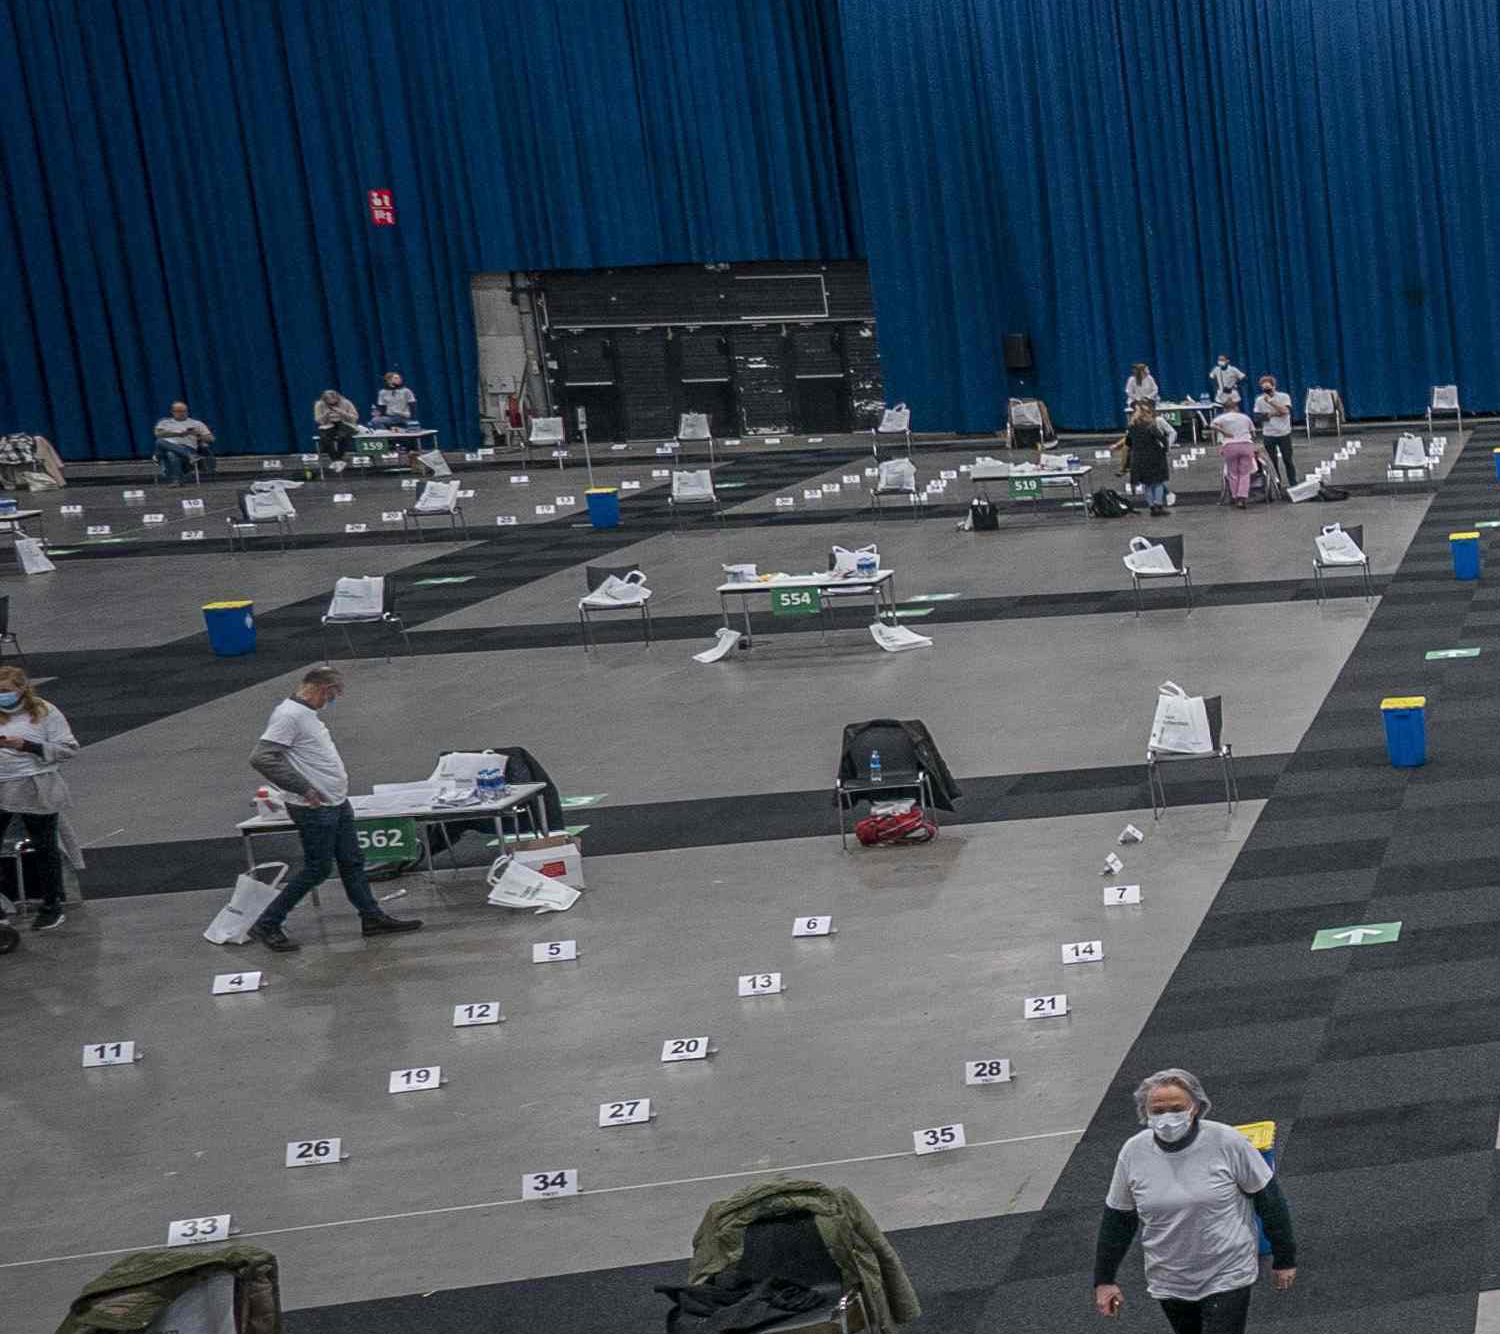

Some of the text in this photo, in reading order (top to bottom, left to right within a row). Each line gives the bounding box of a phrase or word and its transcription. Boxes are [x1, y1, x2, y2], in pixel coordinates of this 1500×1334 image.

[1015, 480, 1036, 490] 519
[781, 593, 811, 606] 554
[357, 829, 404, 848] 562
[1117, 888, 1126, 899] 7
[807, 918, 817, 929] 6
[549, 943, 560, 955] 5
[1072, 944, 1094, 956] 14
[230, 976, 244, 986] 4
[748, 975, 772, 989] 13
[1033, 997, 1055, 1011] 21
[465, 1005, 490, 1018] 12
[94, 1044, 121, 1058] 11
[672, 1040, 698, 1053] 20
[401, 1069, 430, 1084] 19
[975, 1062, 1001, 1077] 28
[609, 1102, 640, 1118] 27
[924, 1127, 955, 1145] 35
[296, 1141, 329, 1158] 26
[534, 1172, 567, 1190] 34
[181, 1219, 217, 1237] 33
